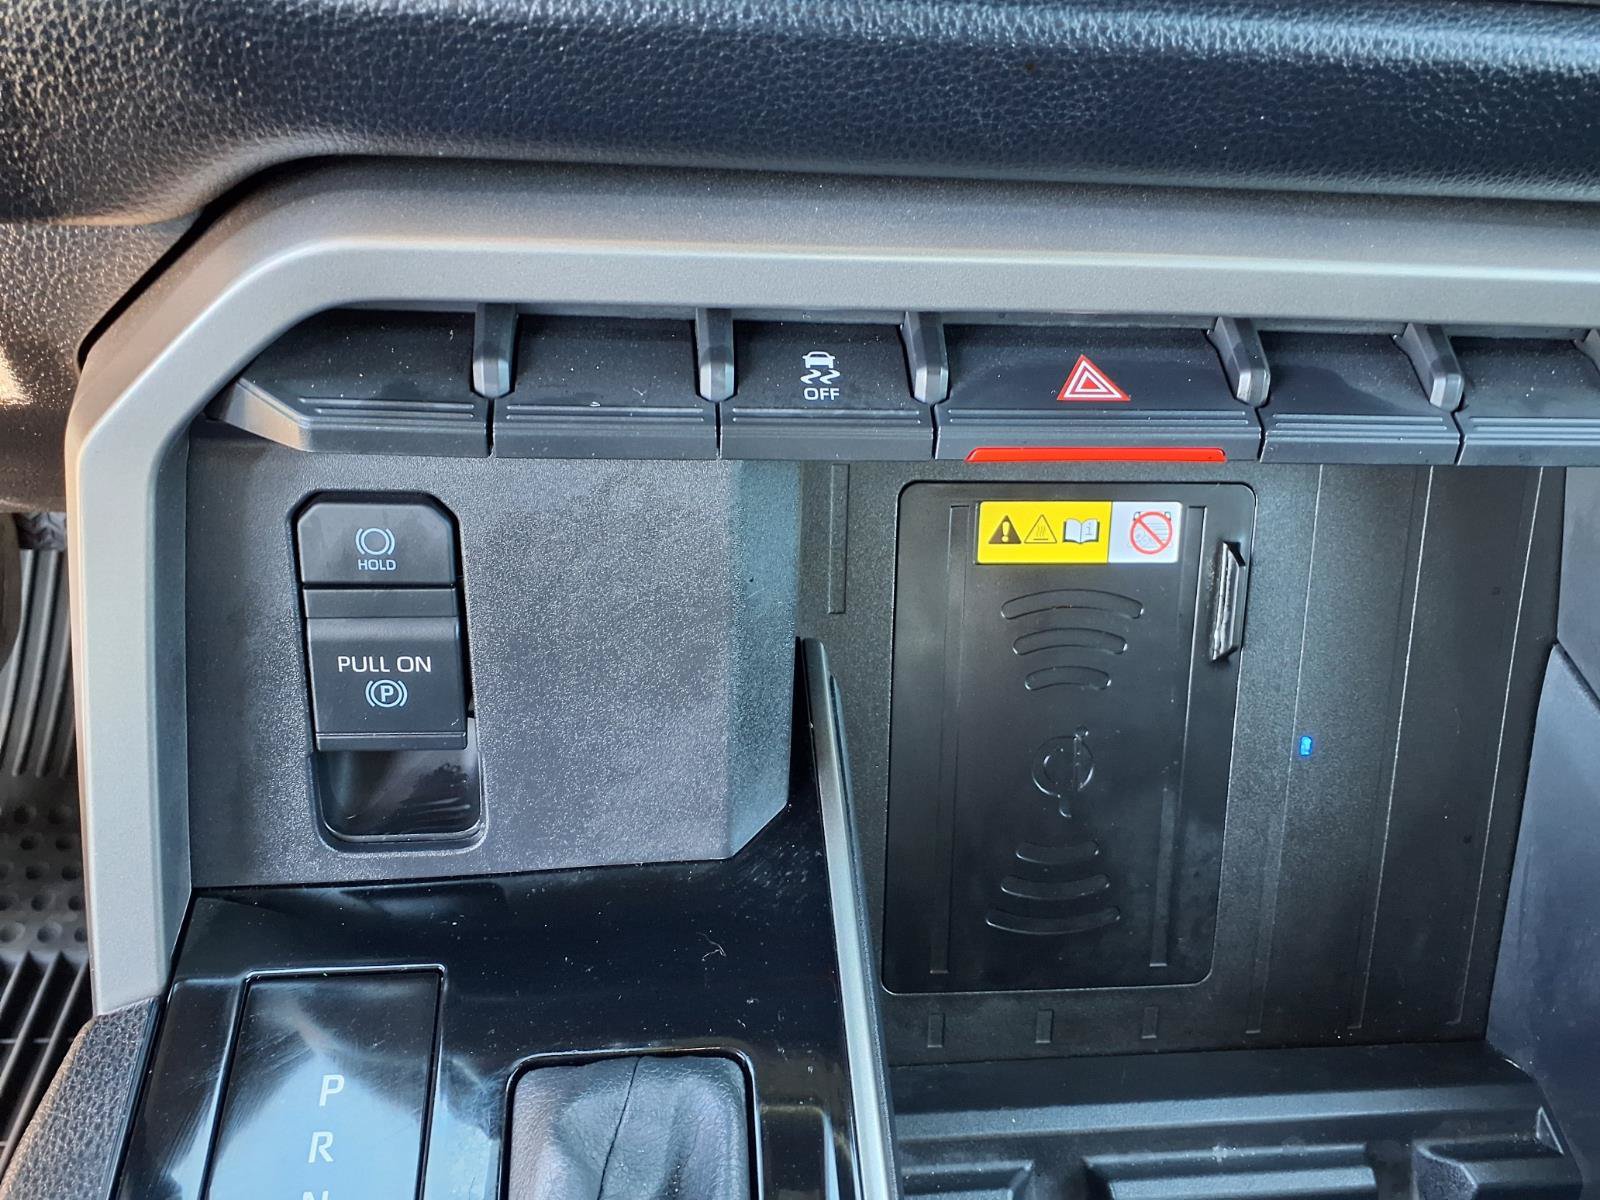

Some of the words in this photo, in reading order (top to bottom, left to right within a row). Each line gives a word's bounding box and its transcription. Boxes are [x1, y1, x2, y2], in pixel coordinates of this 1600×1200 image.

[803, 387, 839, 400] OFF
[358, 559, 396, 570] HOLD
[337, 656, 390, 672] PULL
[396, 656, 431, 672] ON
[319, 1074, 345, 1106] P
[308, 1131, 334, 1163] R
